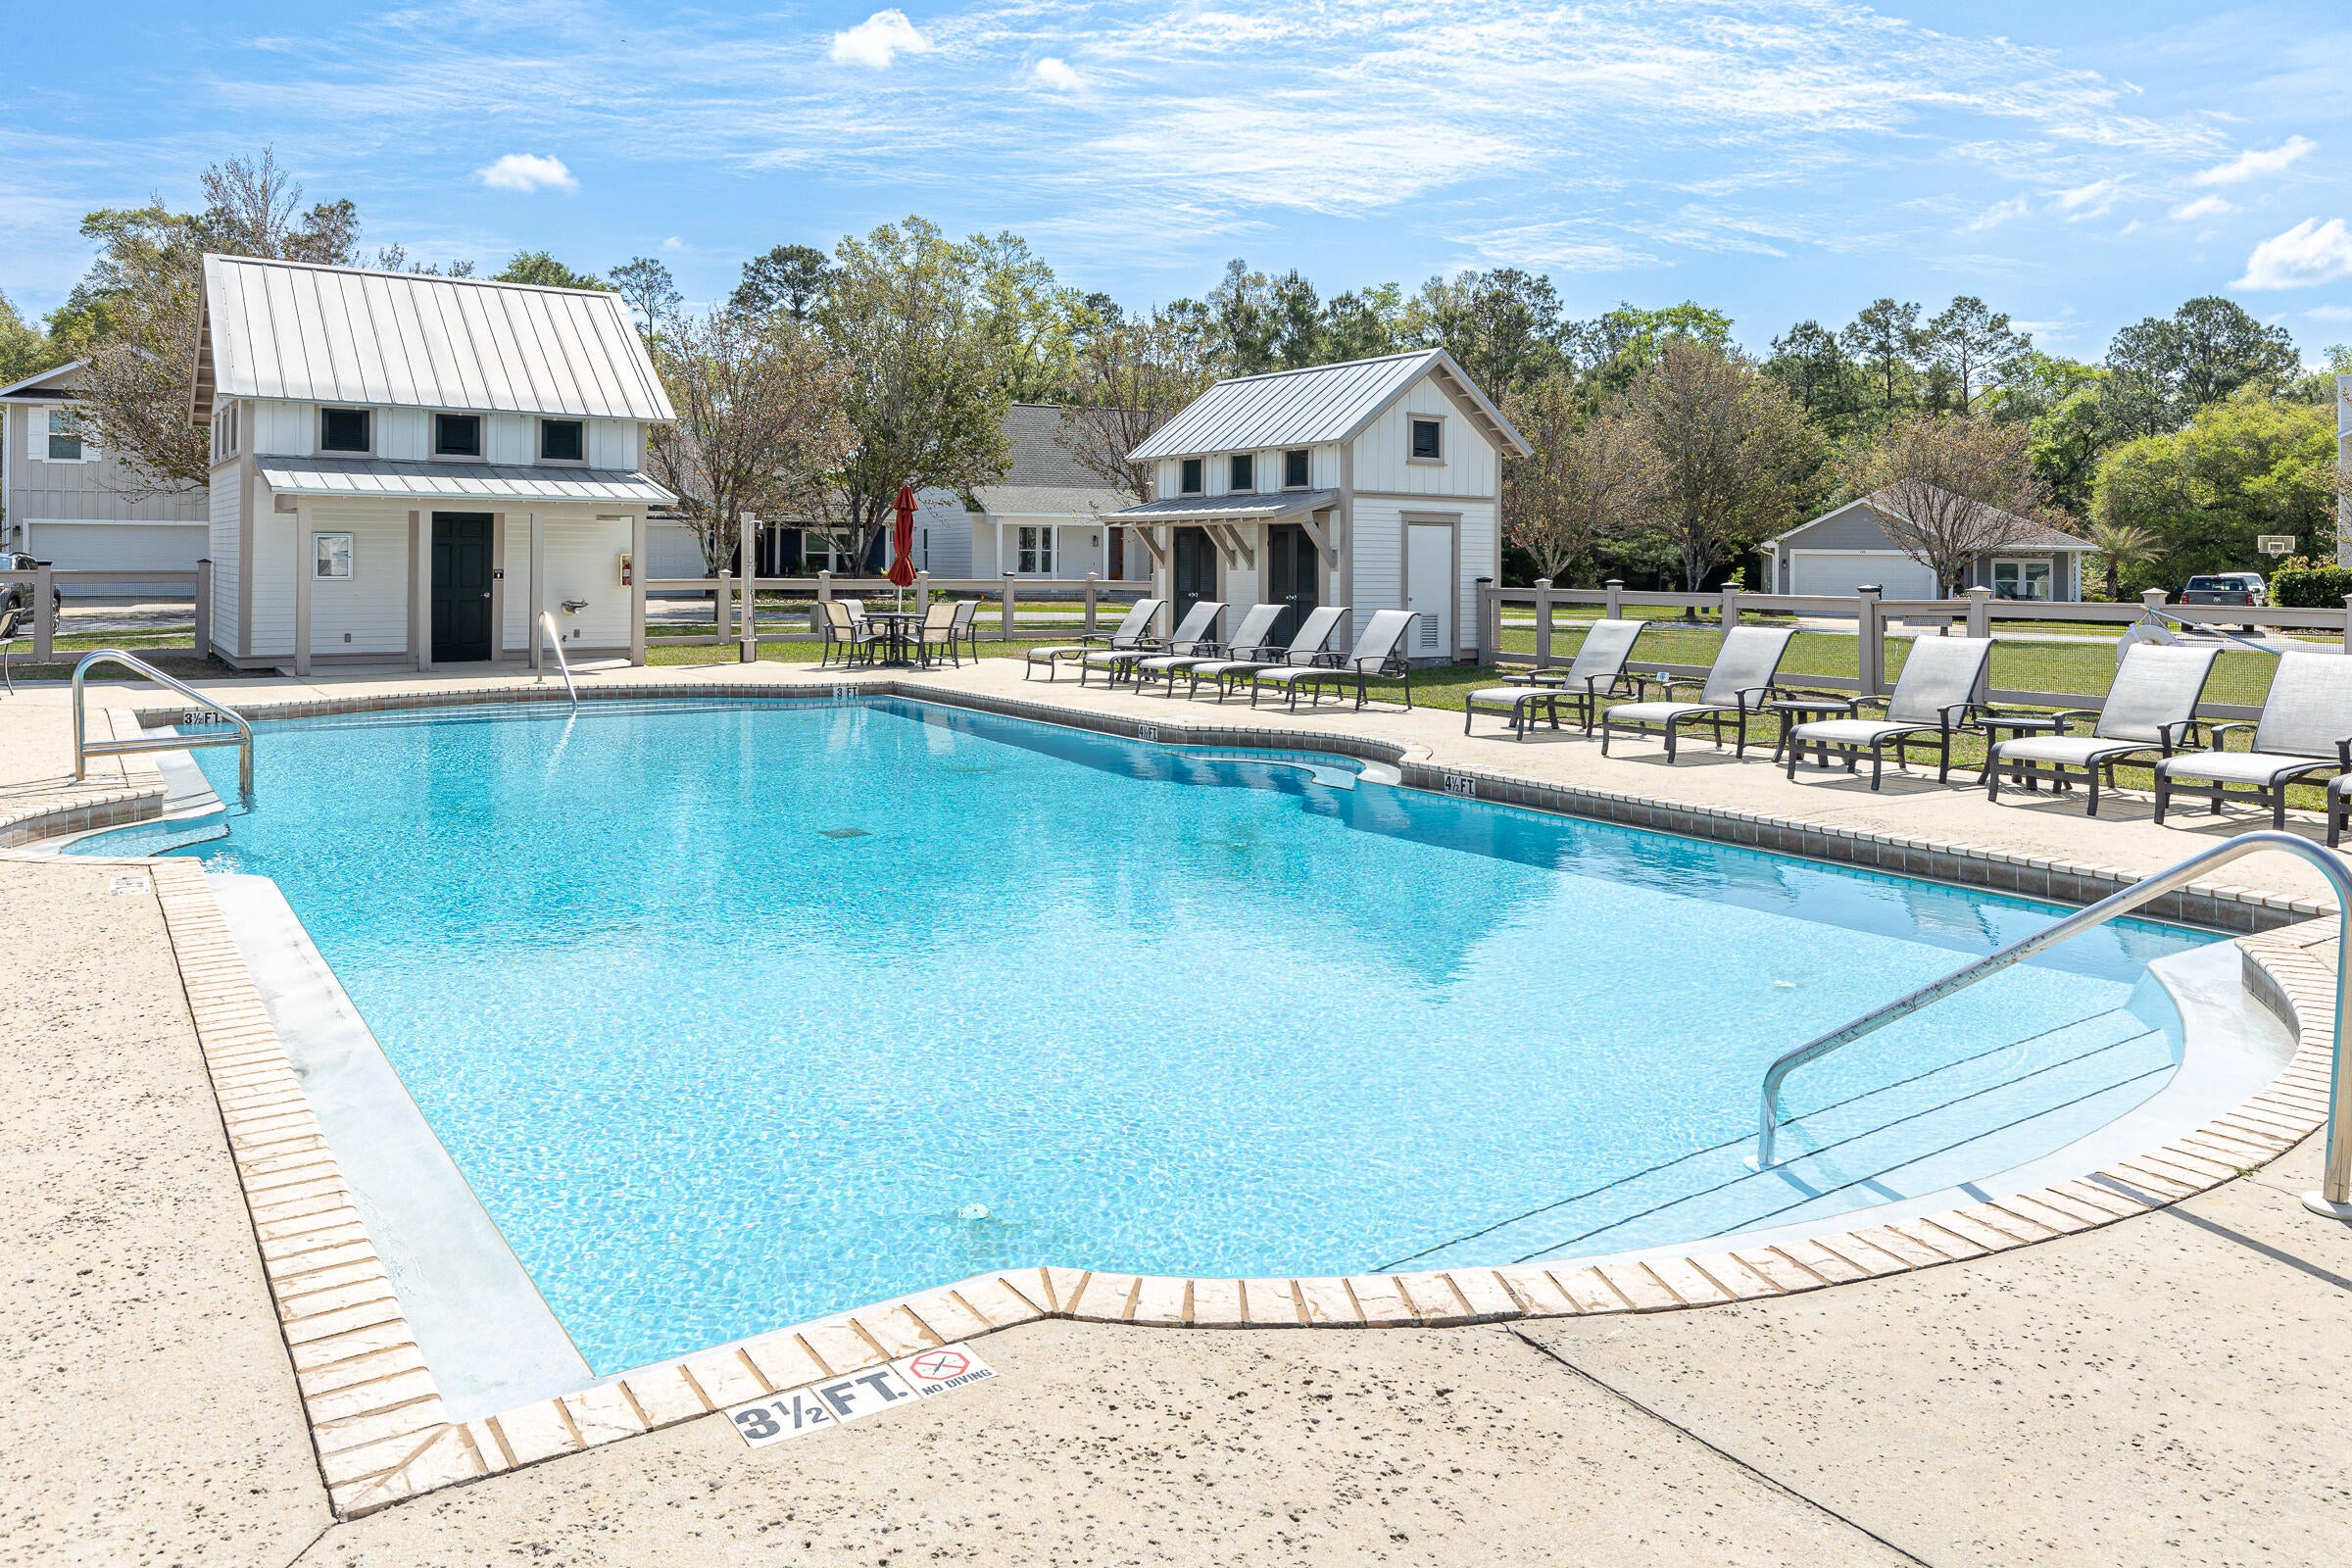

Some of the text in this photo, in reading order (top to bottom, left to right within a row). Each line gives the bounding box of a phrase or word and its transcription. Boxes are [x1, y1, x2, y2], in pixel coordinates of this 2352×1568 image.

[837, 687, 843, 697] 3
[819, 1371, 908, 1416] FT.
[921, 1368, 993, 1396] NO DIVING
